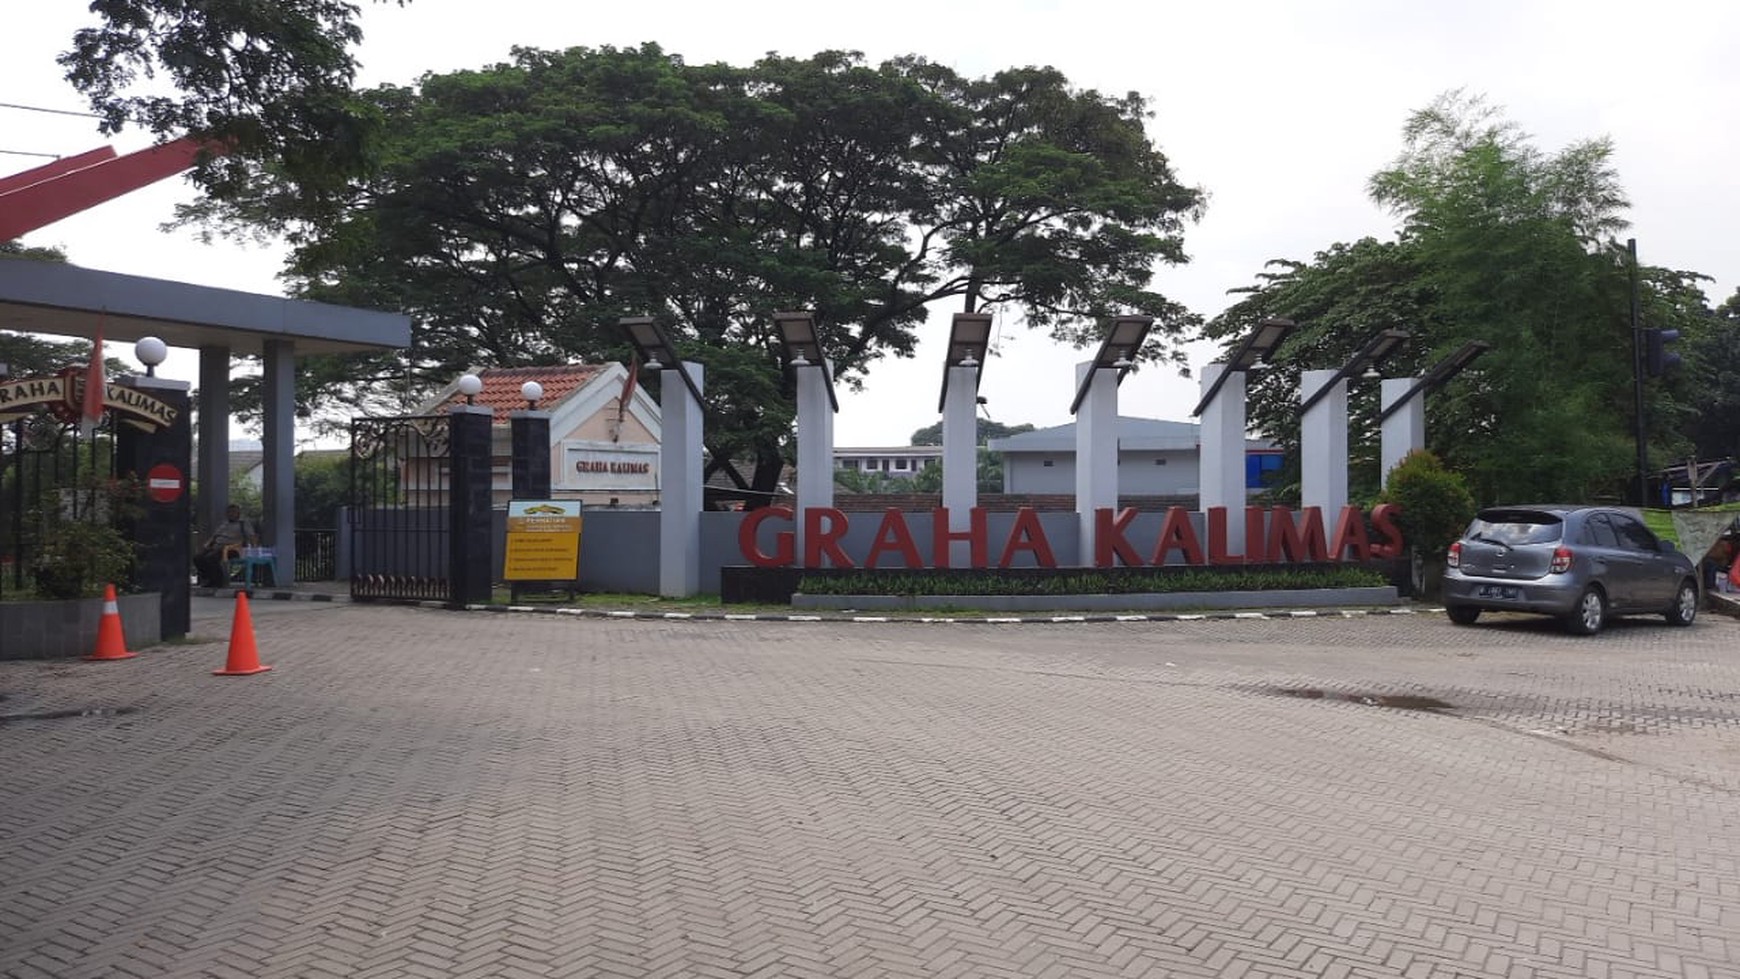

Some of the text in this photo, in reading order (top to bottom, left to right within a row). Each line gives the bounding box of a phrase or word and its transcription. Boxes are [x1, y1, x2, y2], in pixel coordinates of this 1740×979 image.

[106, 385, 175, 423] KALIMAS
[576, 461, 649, 474] GRAHA KALIMAS
[738, 503, 1404, 568] GRAHA KALIMAS
